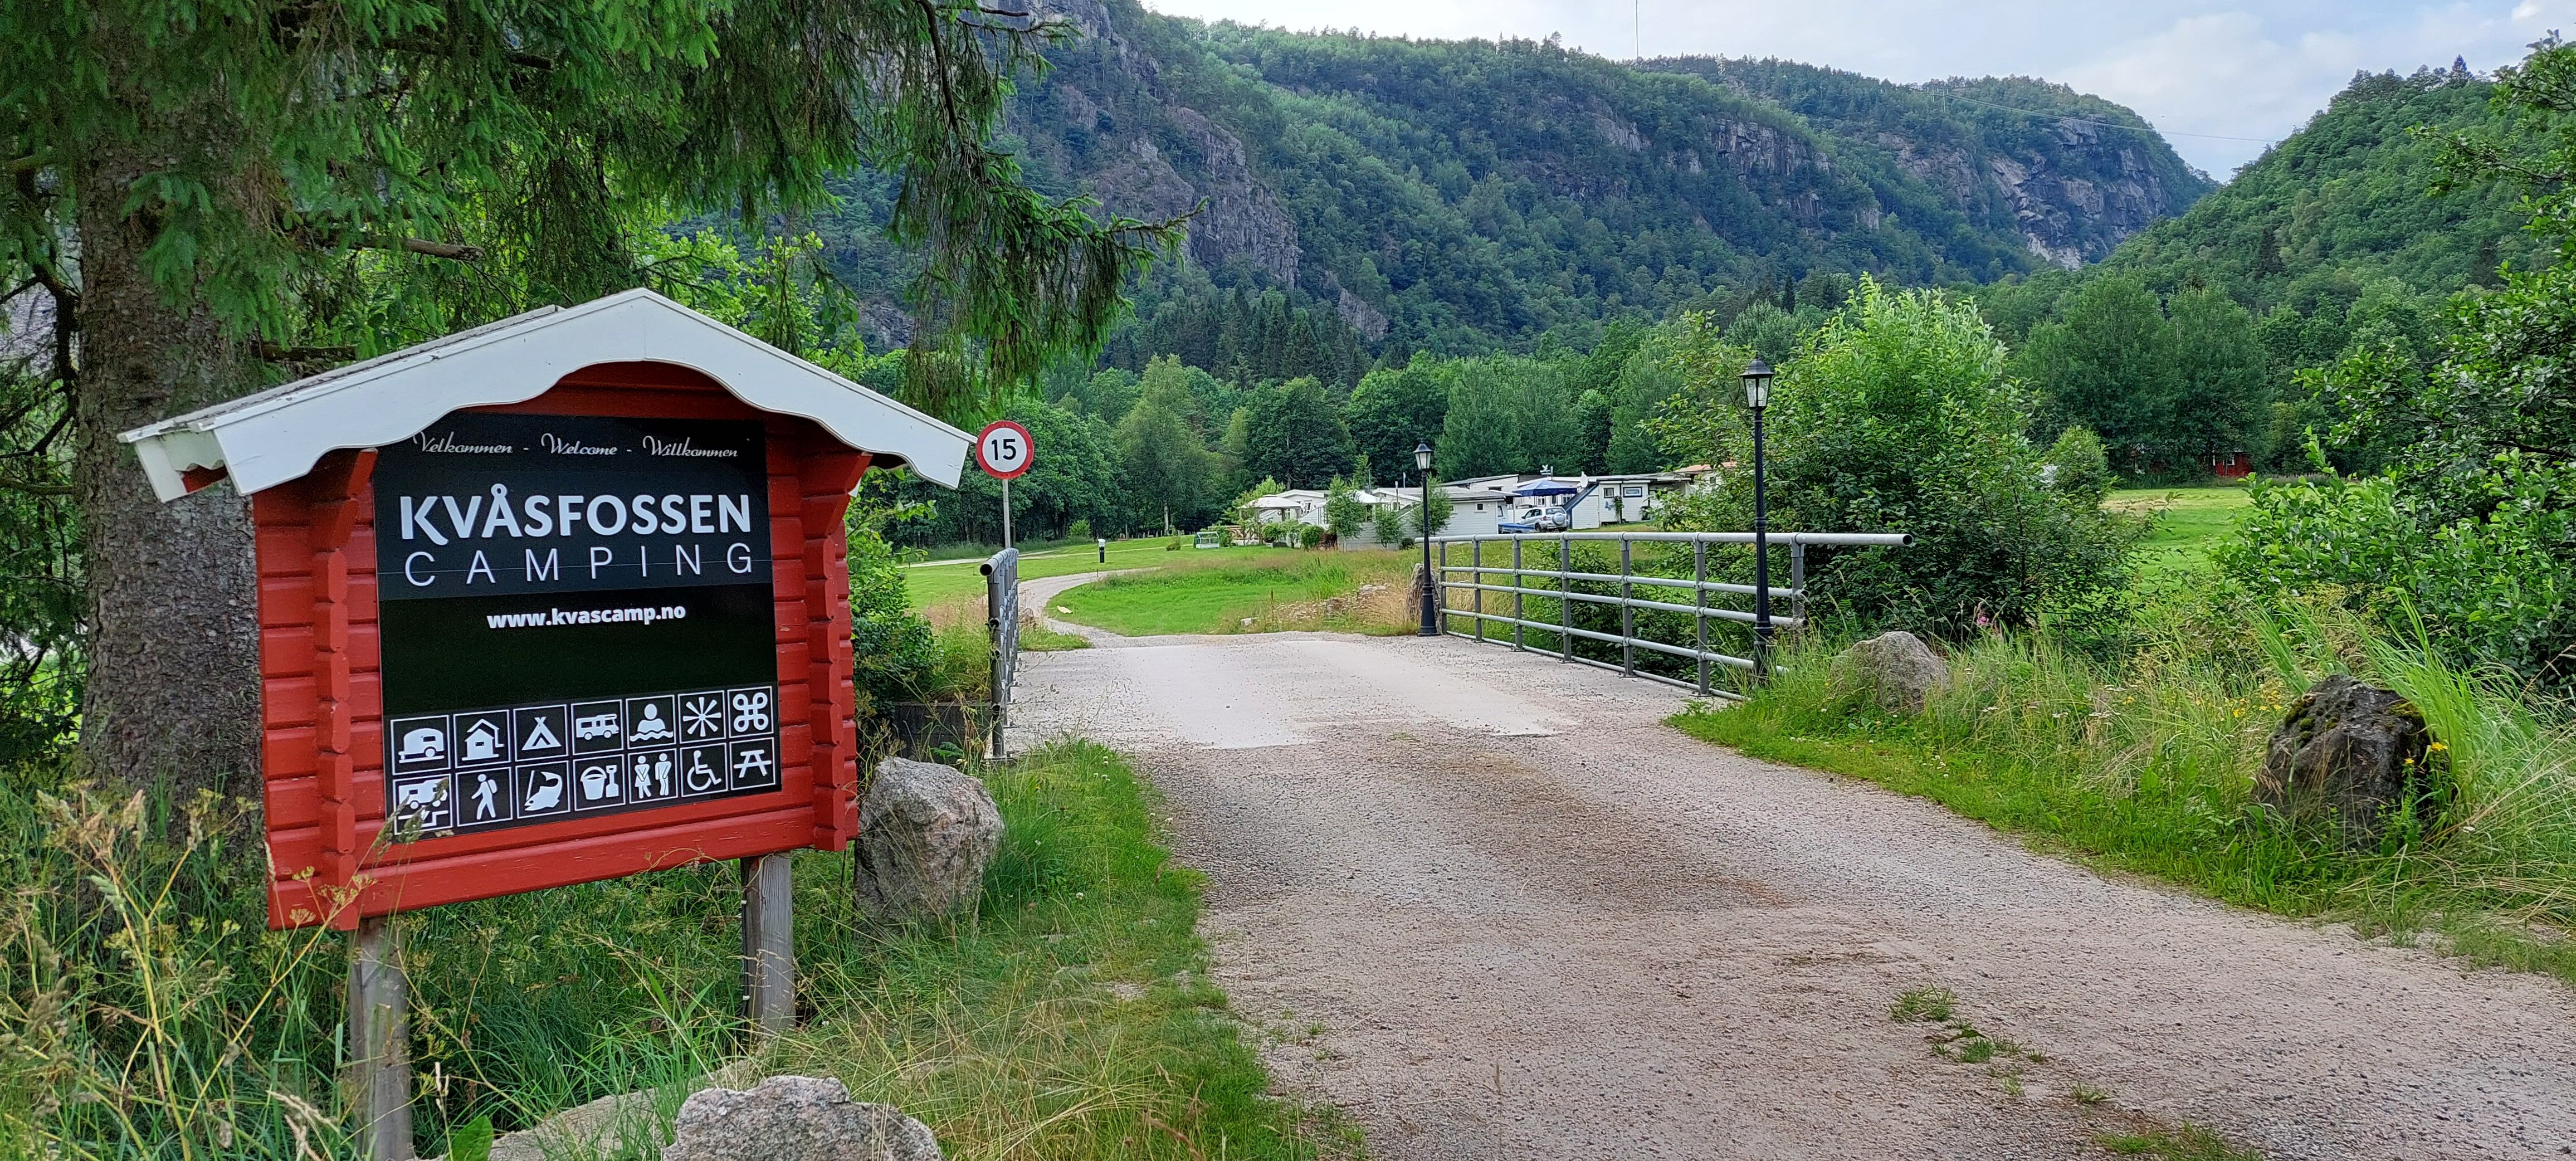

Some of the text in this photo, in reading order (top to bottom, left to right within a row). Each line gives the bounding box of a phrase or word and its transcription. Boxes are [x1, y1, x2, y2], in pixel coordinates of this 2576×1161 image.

[413, 431, 513, 453] Velkommen
[541, 433, 618, 455] Welcome
[642, 435, 738, 457] Willkommen
[991, 438, 1017, 461] 15
[400, 484, 751, 545] KVÅSFOSSEN
[405, 543, 752, 586] CAMPING
[487, 606, 686, 628] www.kvascamp.no
